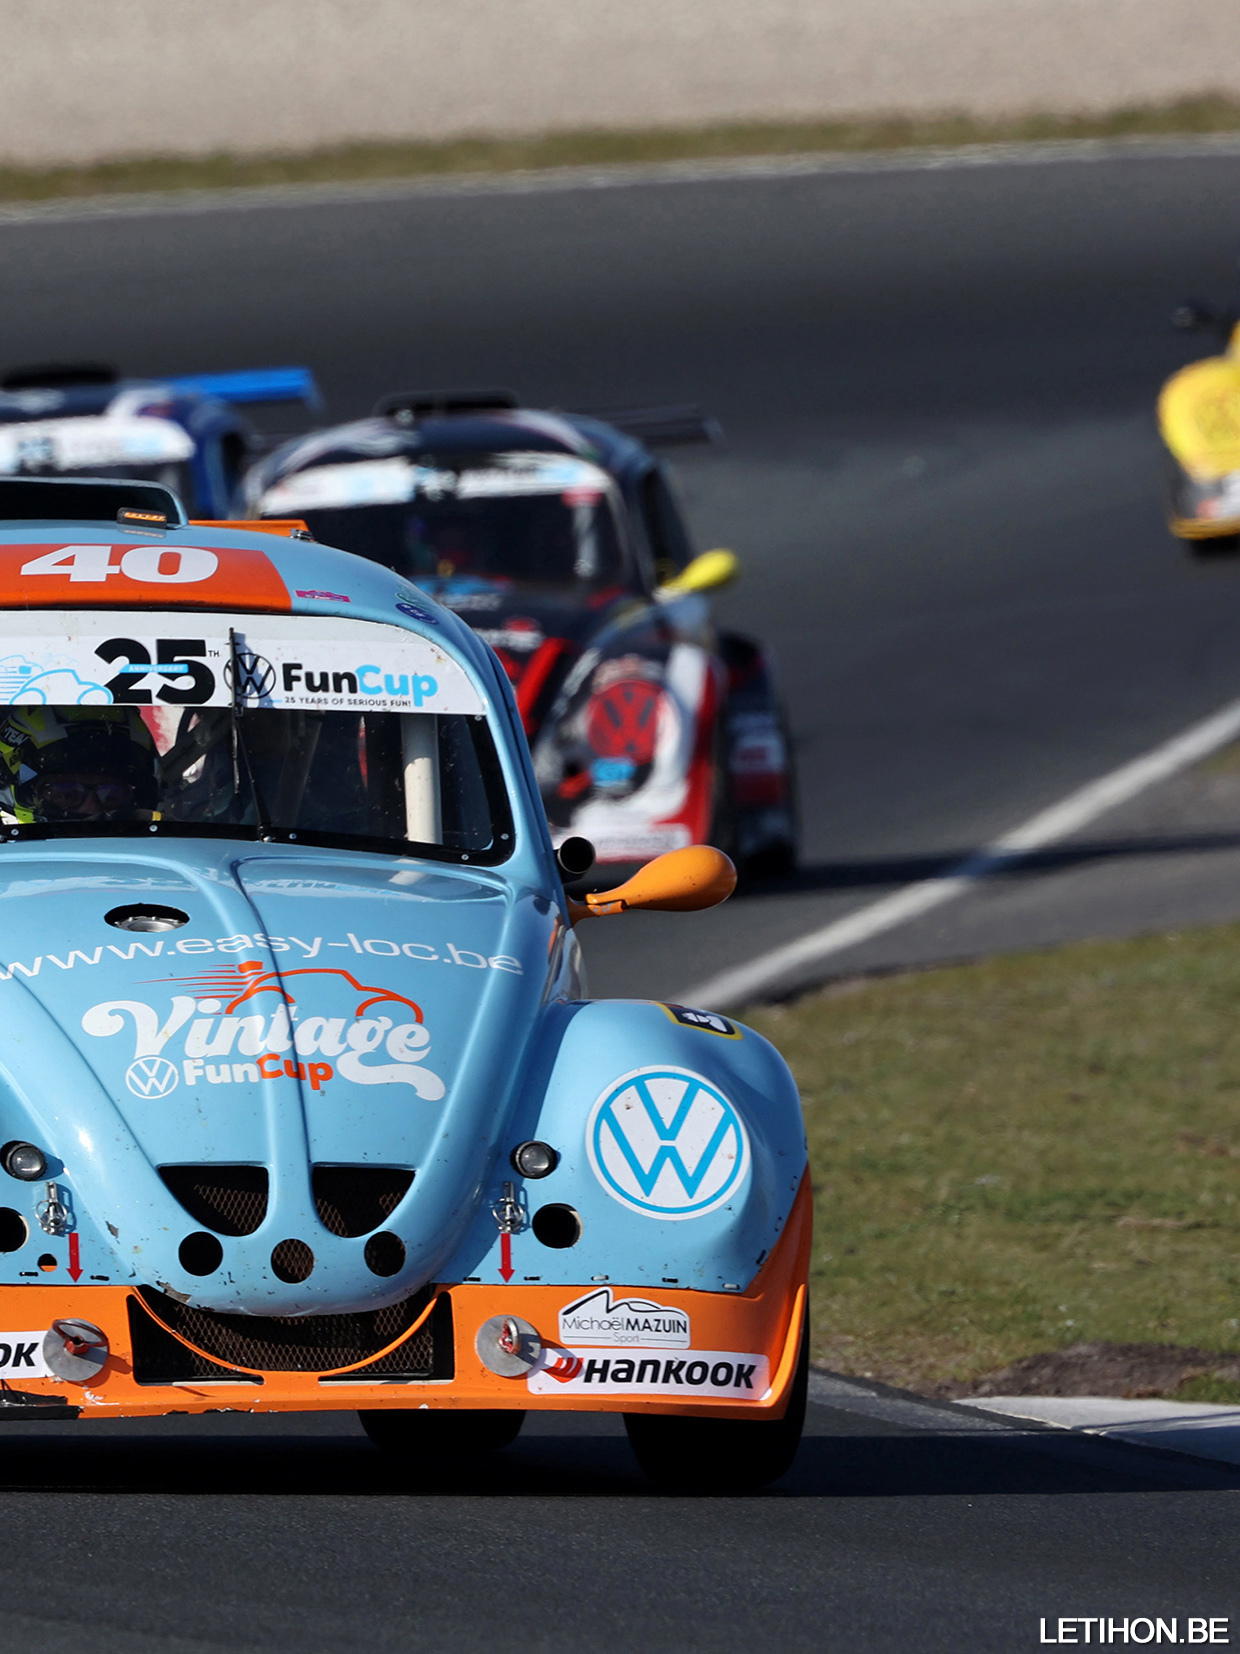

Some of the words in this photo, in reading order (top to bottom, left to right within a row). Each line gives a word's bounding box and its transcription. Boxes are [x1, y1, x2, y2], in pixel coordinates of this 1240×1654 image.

[20, 545, 219, 584] 40
[94, 638, 216, 704] 25
[282, 662, 439, 707] FunCup
[299, 697, 328, 705] YEARS
[331, 698, 344, 706] OF
[390, 699, 412, 707] FUN!
[81, 995, 447, 1101] Vintage
[184, 1052, 334, 1092] FunCup
[613, 1332, 640, 1344] Sport
